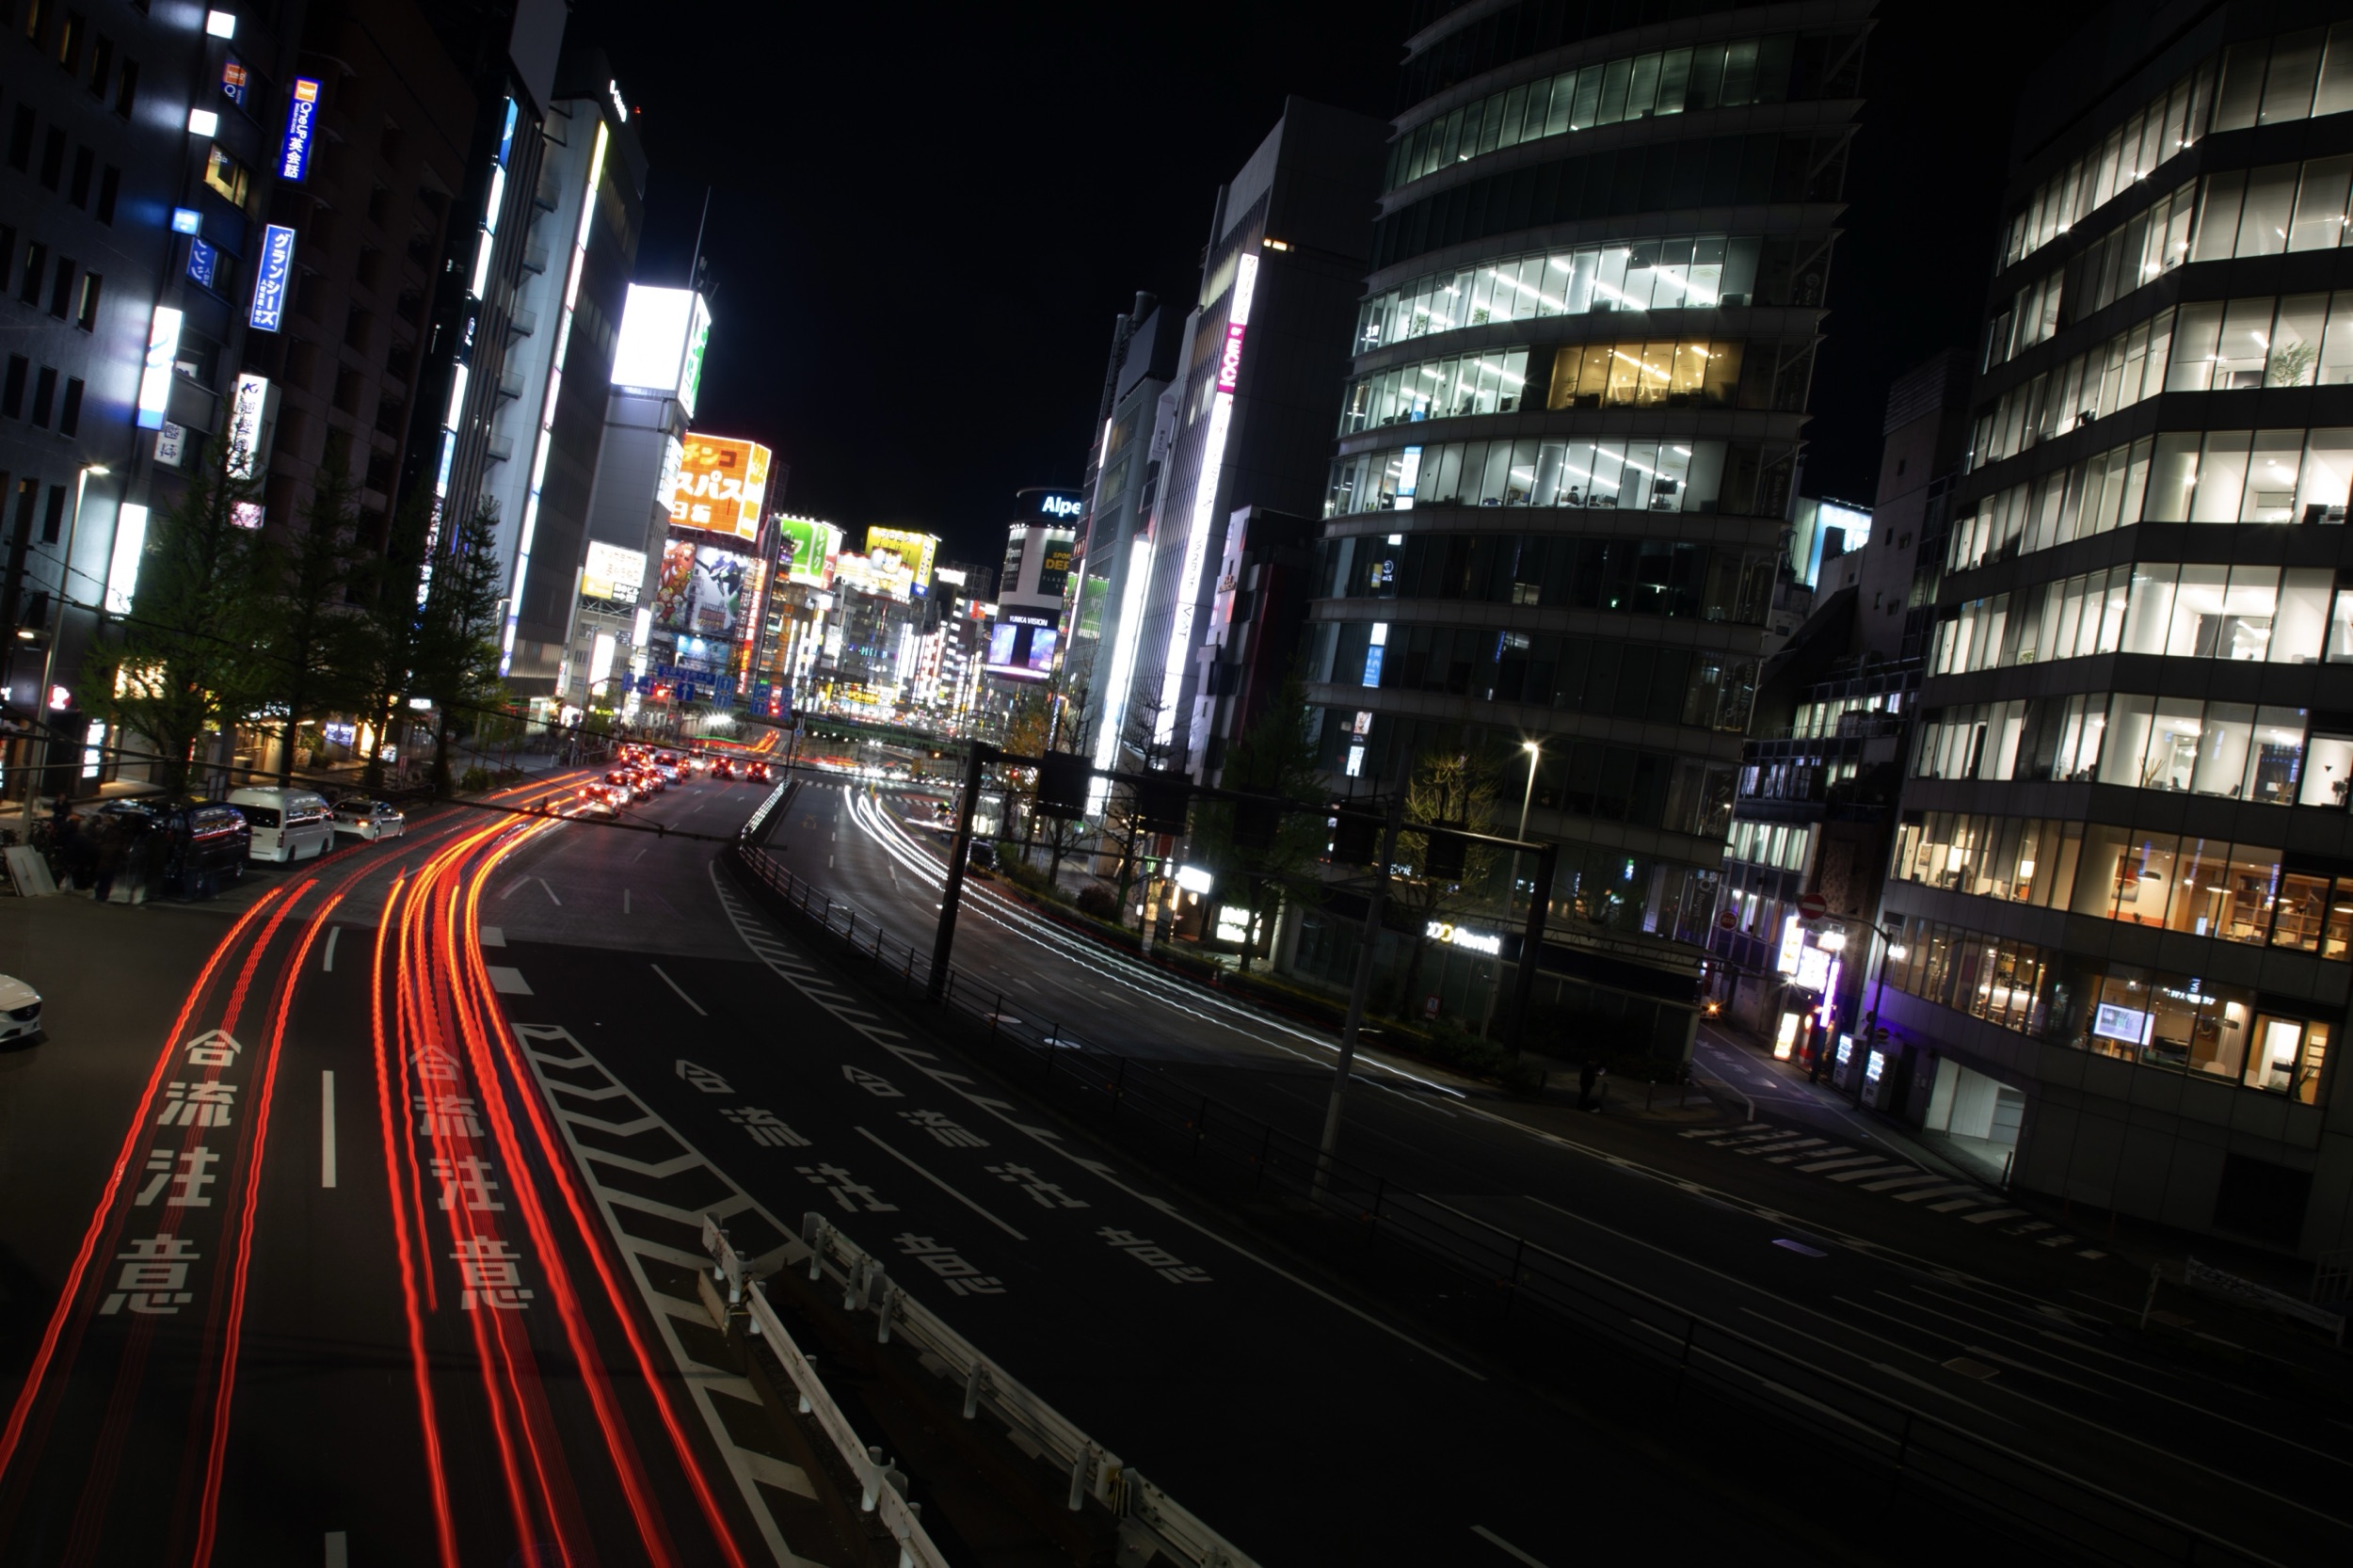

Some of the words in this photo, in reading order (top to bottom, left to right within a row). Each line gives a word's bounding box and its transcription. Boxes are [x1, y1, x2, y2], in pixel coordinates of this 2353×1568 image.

[296, 102, 312, 140] OneUP
[260, 232, 292, 326] グランシーズ
[813, 528, 825, 569] レイク
[1009, 615, 1027, 625] YUNIKA
[1027, 616, 1048, 627] VISION
[99, 1029, 241, 1315] 合流注意
[408, 1044, 535, 1310] 合流注意
[676, 1059, 1006, 1295] 合流注意
[841, 1064, 1213, 1284] 合流注意
